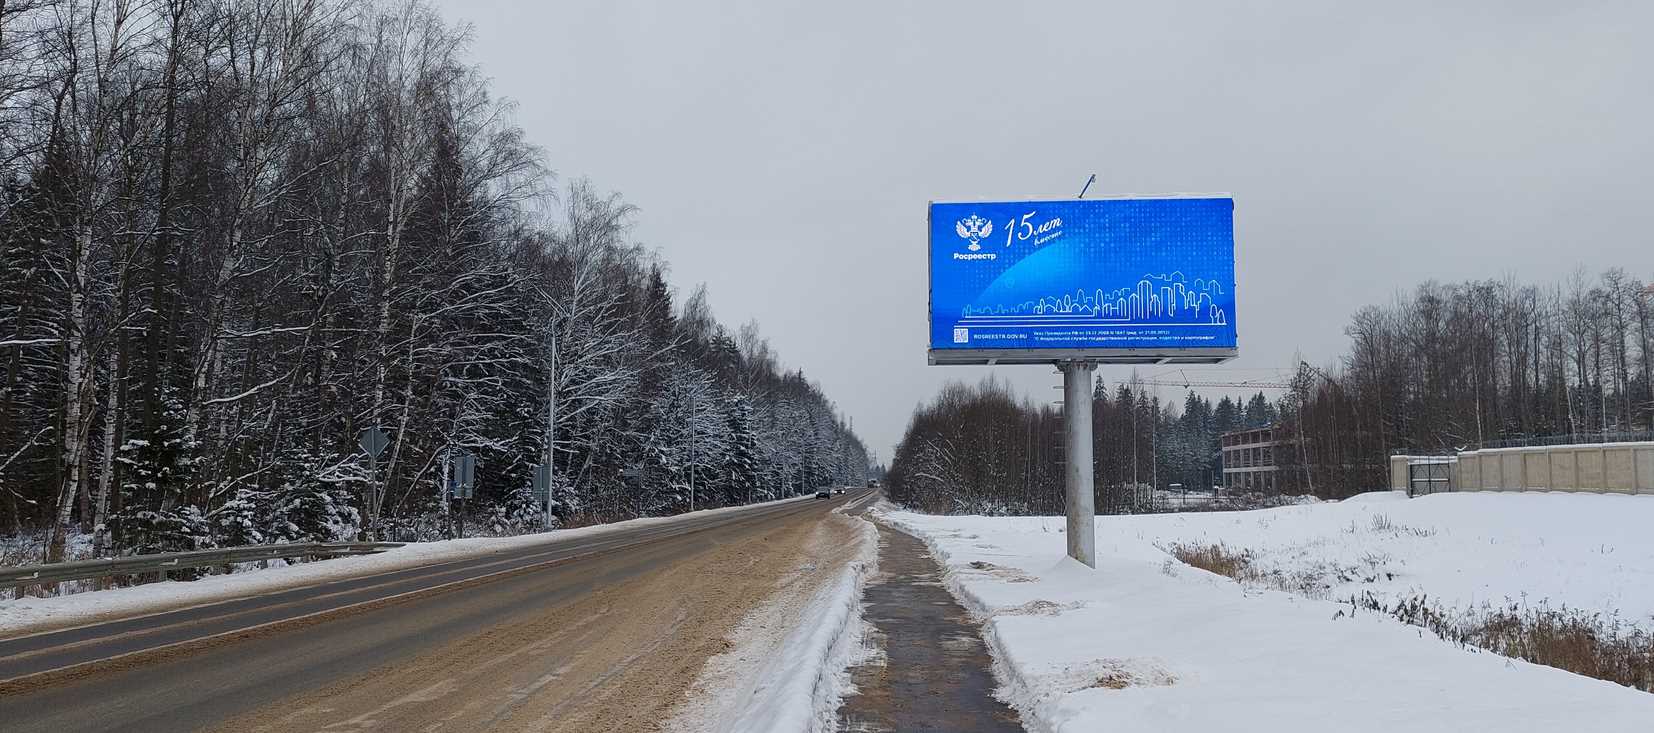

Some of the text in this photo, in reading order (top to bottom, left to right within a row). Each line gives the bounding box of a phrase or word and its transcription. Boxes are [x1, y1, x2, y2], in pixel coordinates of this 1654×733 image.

[1004, 210, 1063, 248] 15 лет
[953, 252, 997, 261] Росреестр
